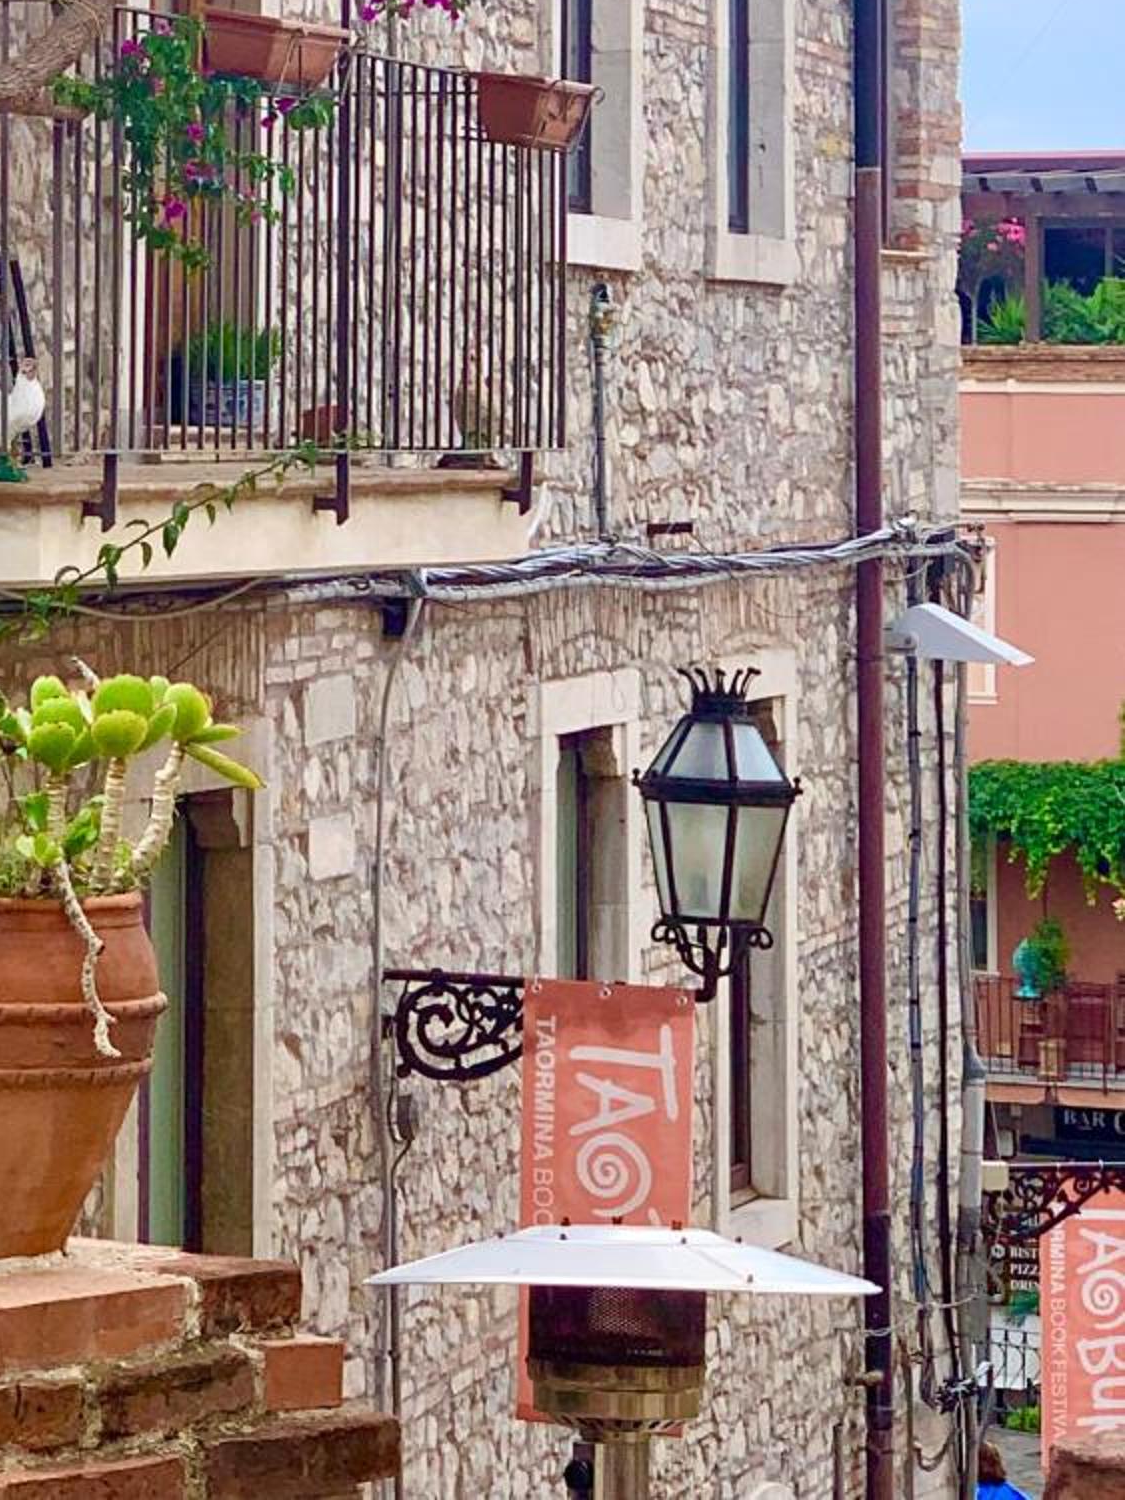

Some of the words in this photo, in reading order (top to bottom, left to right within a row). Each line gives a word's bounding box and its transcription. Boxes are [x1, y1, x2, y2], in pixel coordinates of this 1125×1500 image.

[533, 1015, 557, 1161] TAORMINA
[569, 1023, 679, 1226] TAO
[532, 1167, 554, 1226] BOO
[1010, 1247, 1038, 1259] BIST
[1010, 1263, 1039, 1275] PIZZ
[1050, 1297, 1068, 1355] BOOK
[1050, 1359, 1068, 1441] FESTIVA
